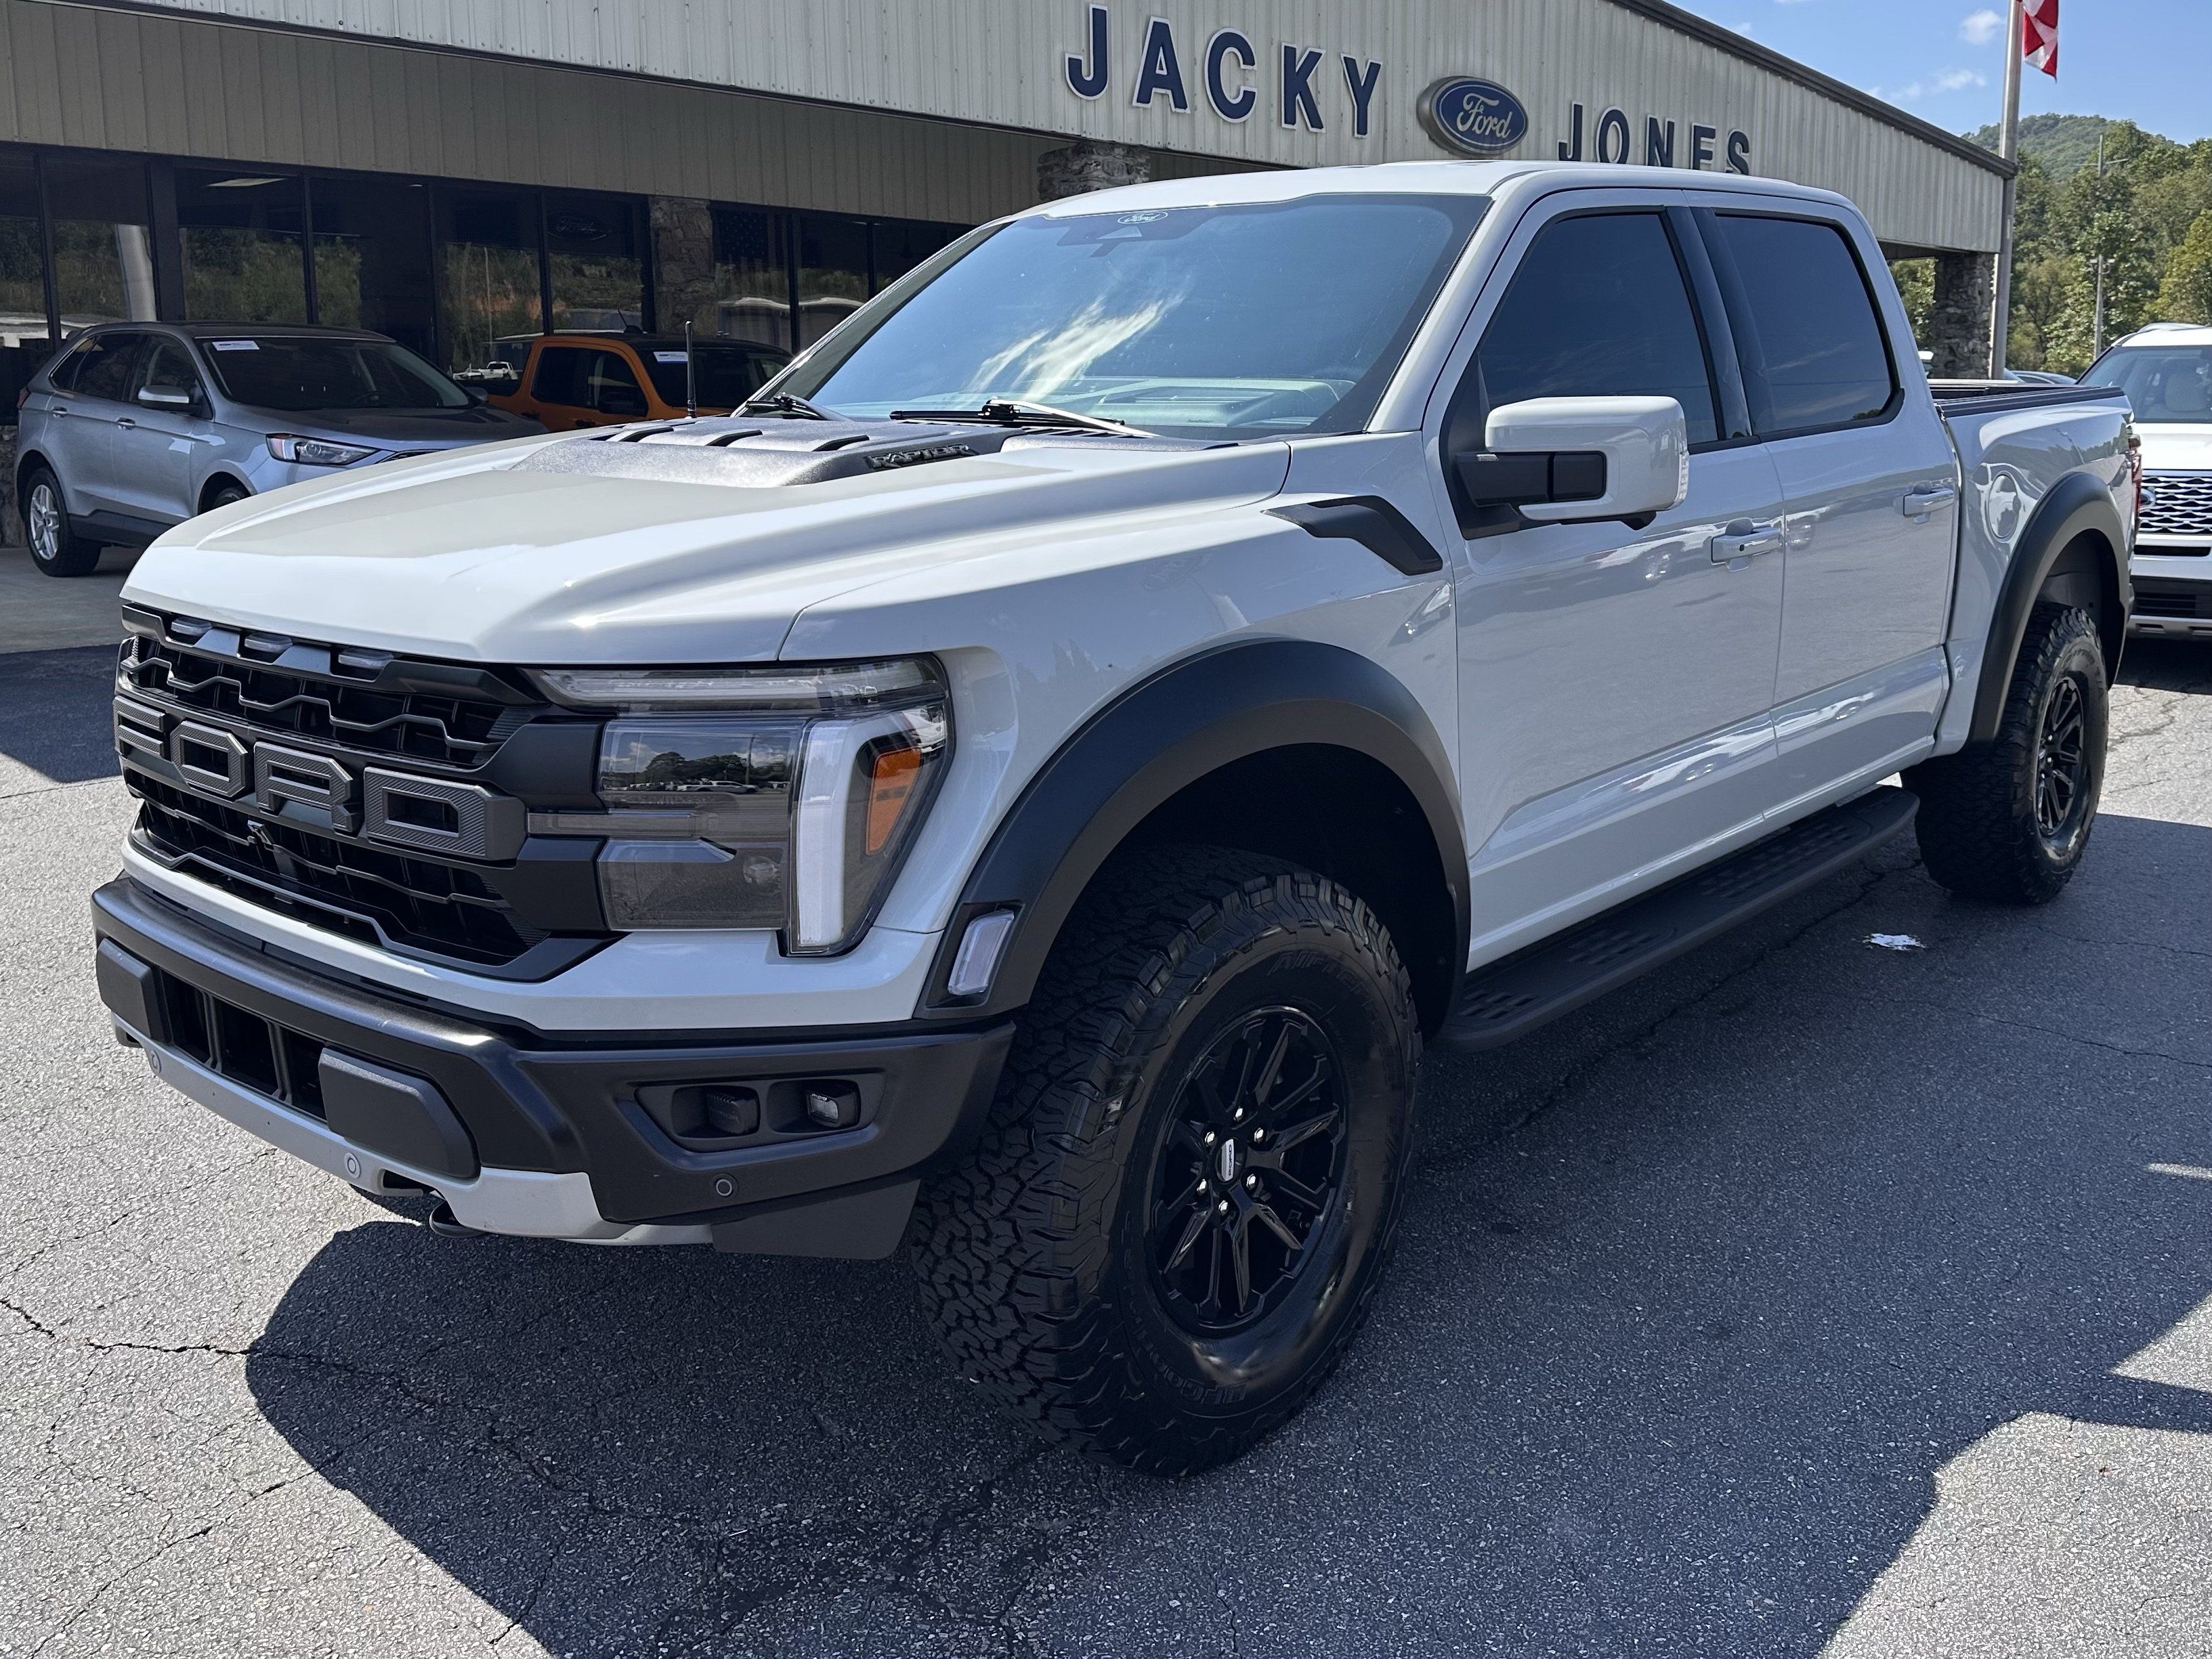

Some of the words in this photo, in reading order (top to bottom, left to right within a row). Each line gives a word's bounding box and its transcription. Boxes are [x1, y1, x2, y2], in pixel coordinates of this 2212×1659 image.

[1065, 3, 1383, 139] JACKY
[1557, 101, 1749, 176] JONES
[1456, 93, 1513, 139] Ford
[866, 444, 980, 469] RAPTOR
[112, 695, 518, 865] FORD
